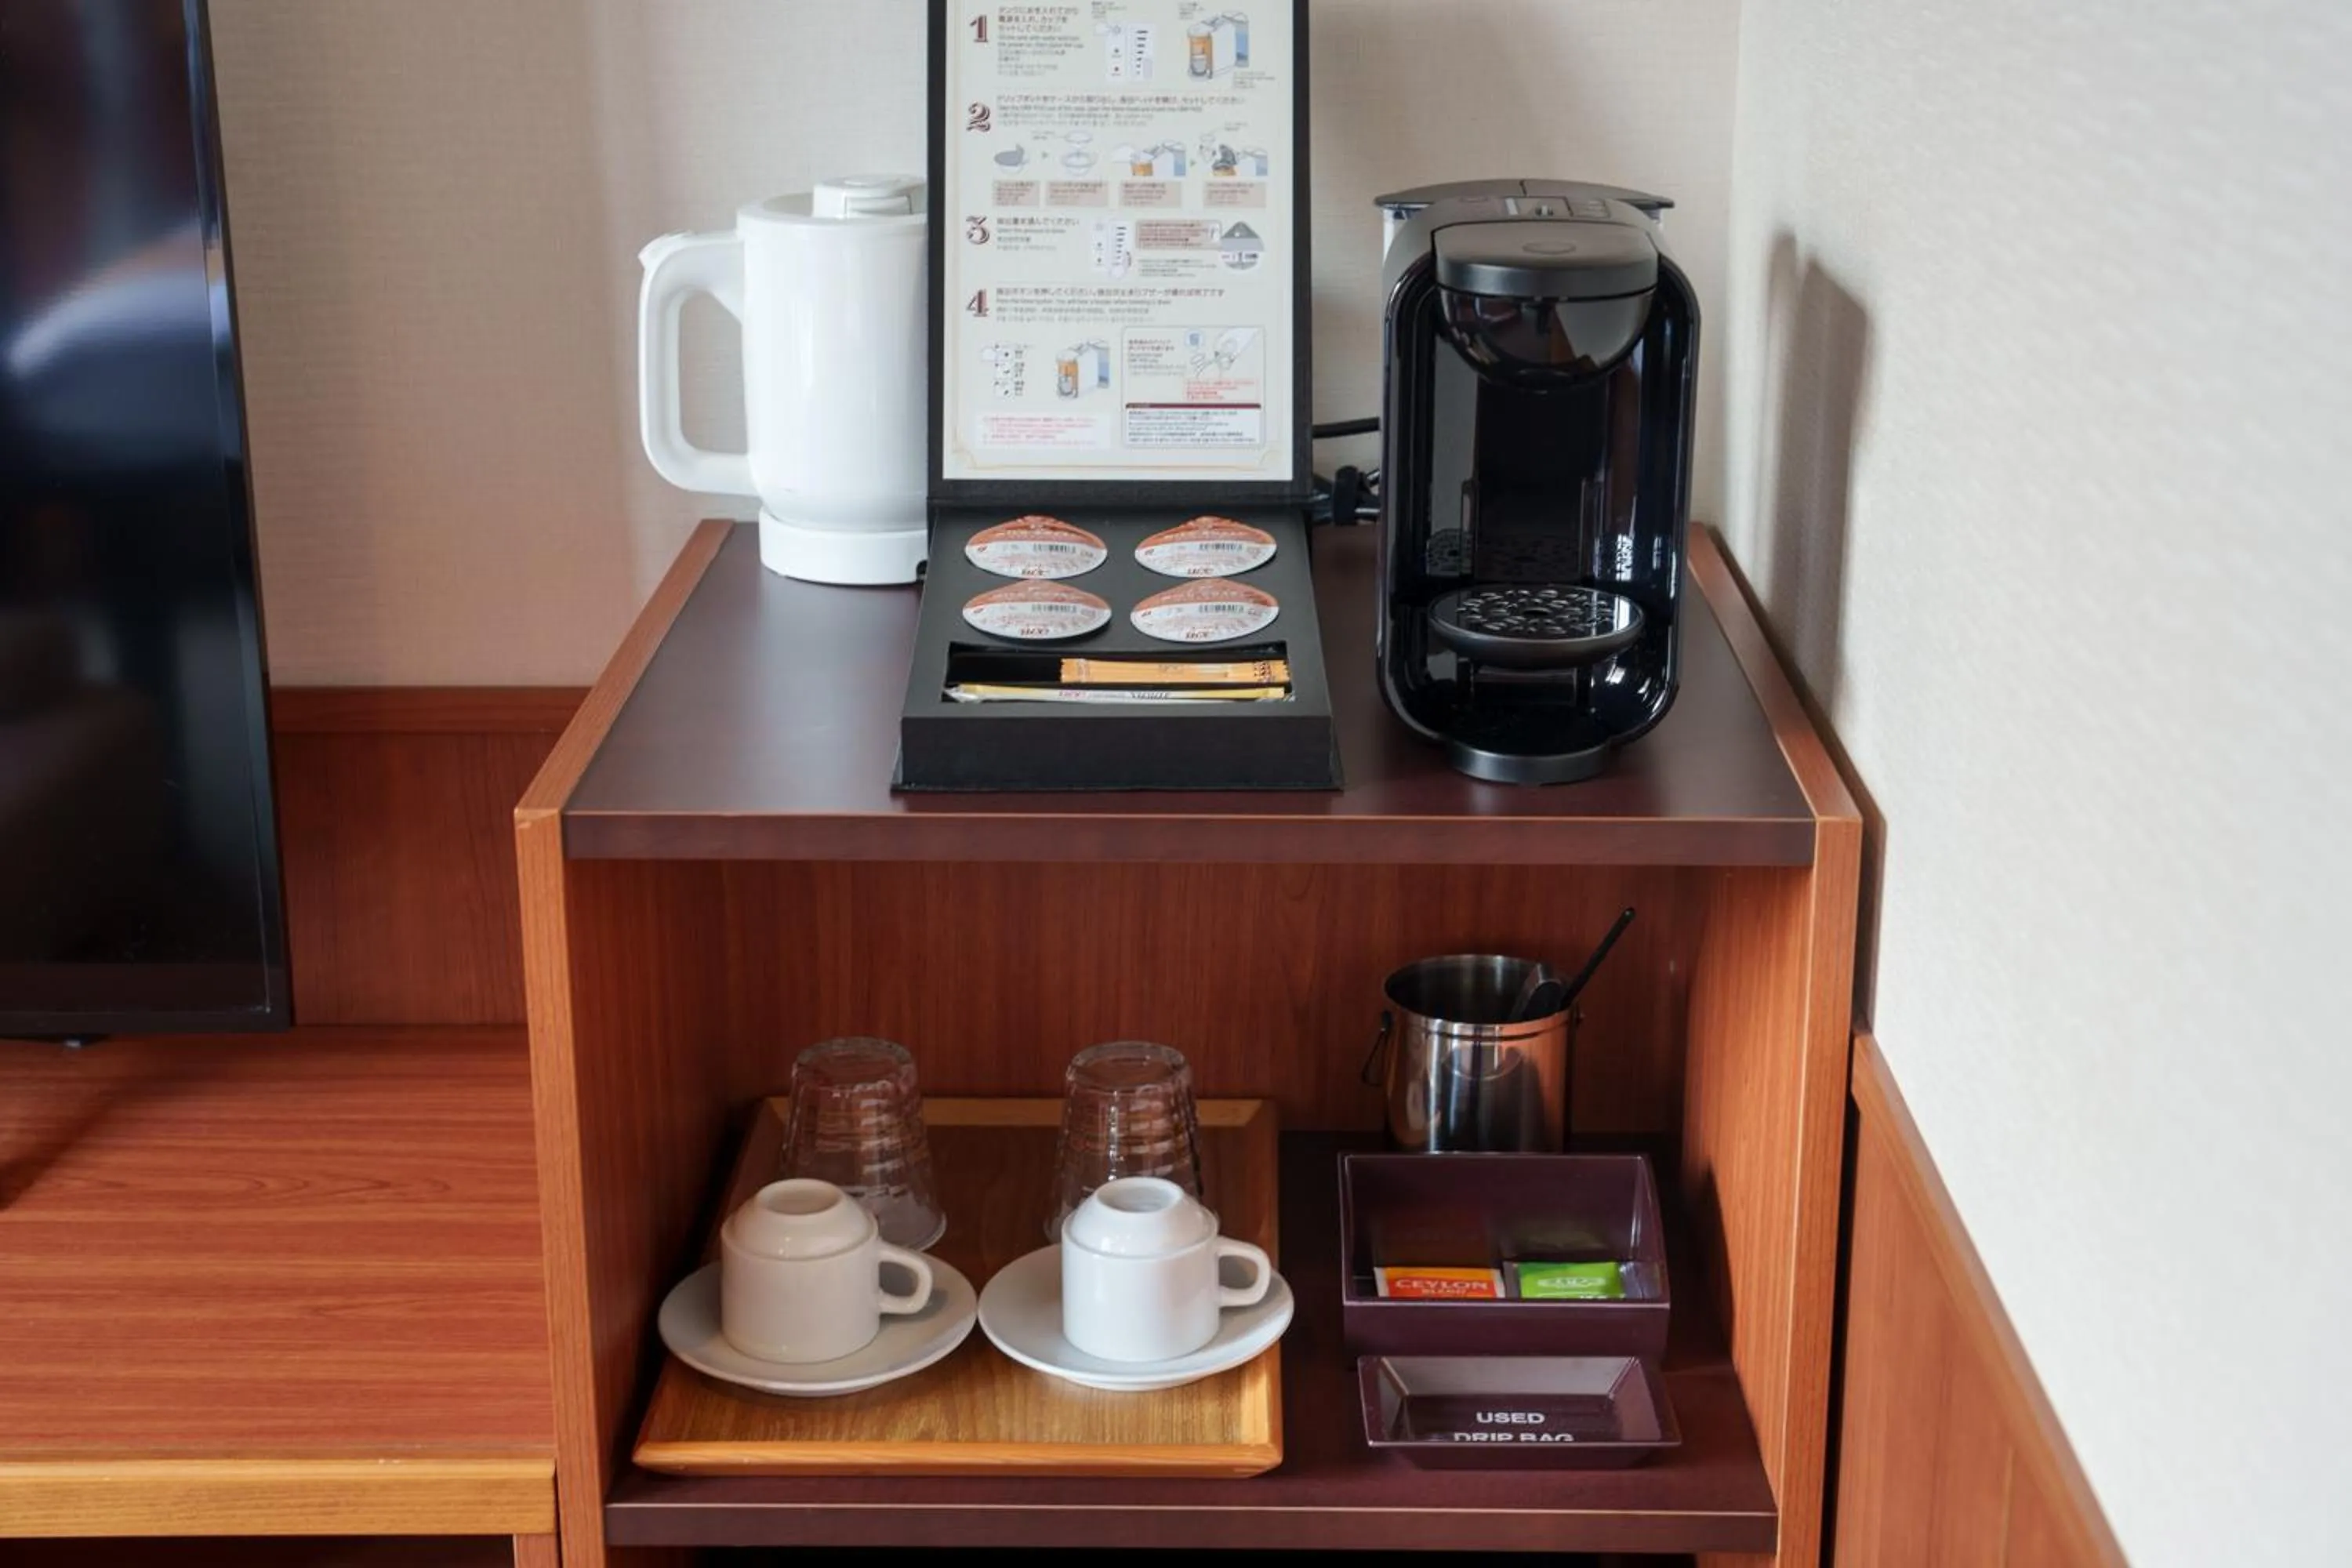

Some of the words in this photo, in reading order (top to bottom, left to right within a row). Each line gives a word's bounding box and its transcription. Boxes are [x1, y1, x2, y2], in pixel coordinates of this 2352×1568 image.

[970, 15, 989, 42] 1
[966, 102, 990, 132] 2
[965, 216, 990, 245] 3
[966, 289, 989, 317] 4
[1396, 1279, 1488, 1290] CEYLON
[1475, 1411, 1546, 1425] USED
[1454, 1432, 1514, 1442] DRIP
[1519, 1432, 1574, 1442] BAG
